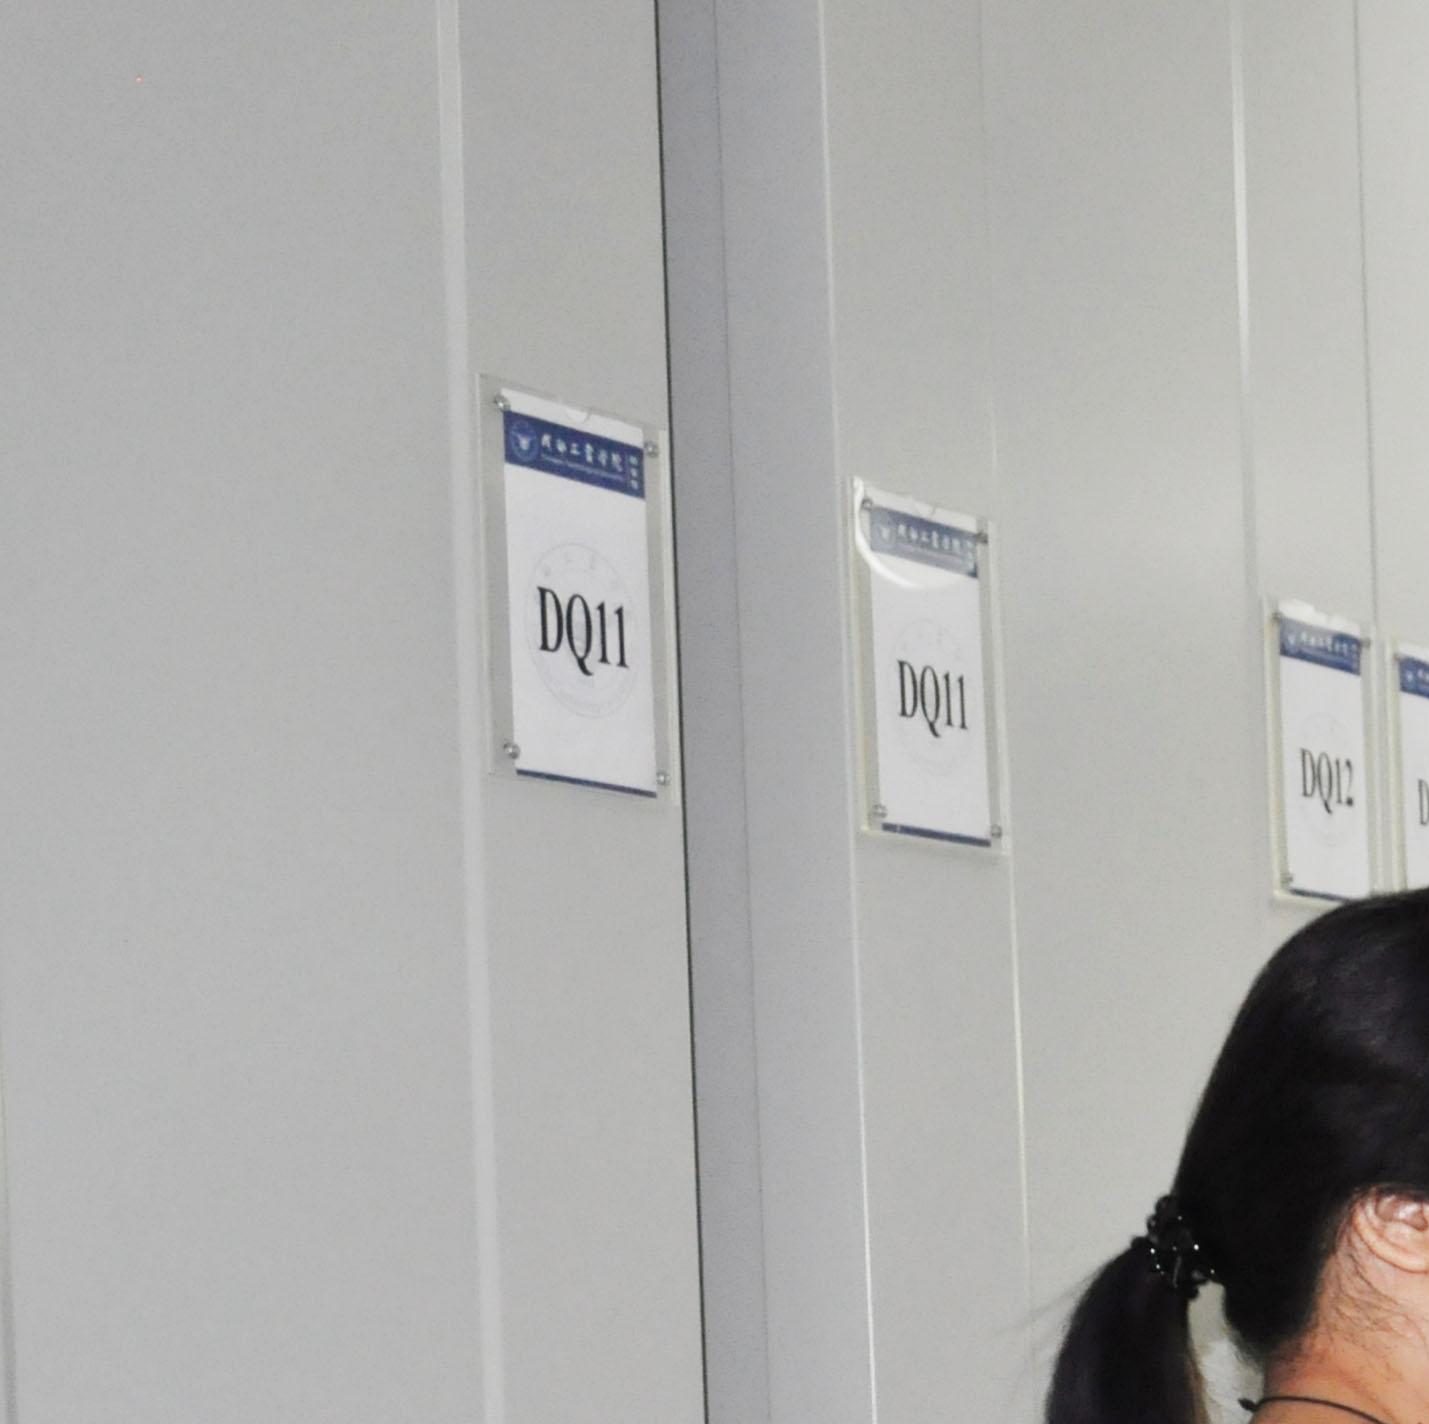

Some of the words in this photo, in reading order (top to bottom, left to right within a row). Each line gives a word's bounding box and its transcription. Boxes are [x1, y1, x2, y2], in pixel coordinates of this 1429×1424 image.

[537, 585, 629, 676] DQ11
[897, 659, 968, 738] DQ11
[1300, 747, 1354, 814] DQ12
